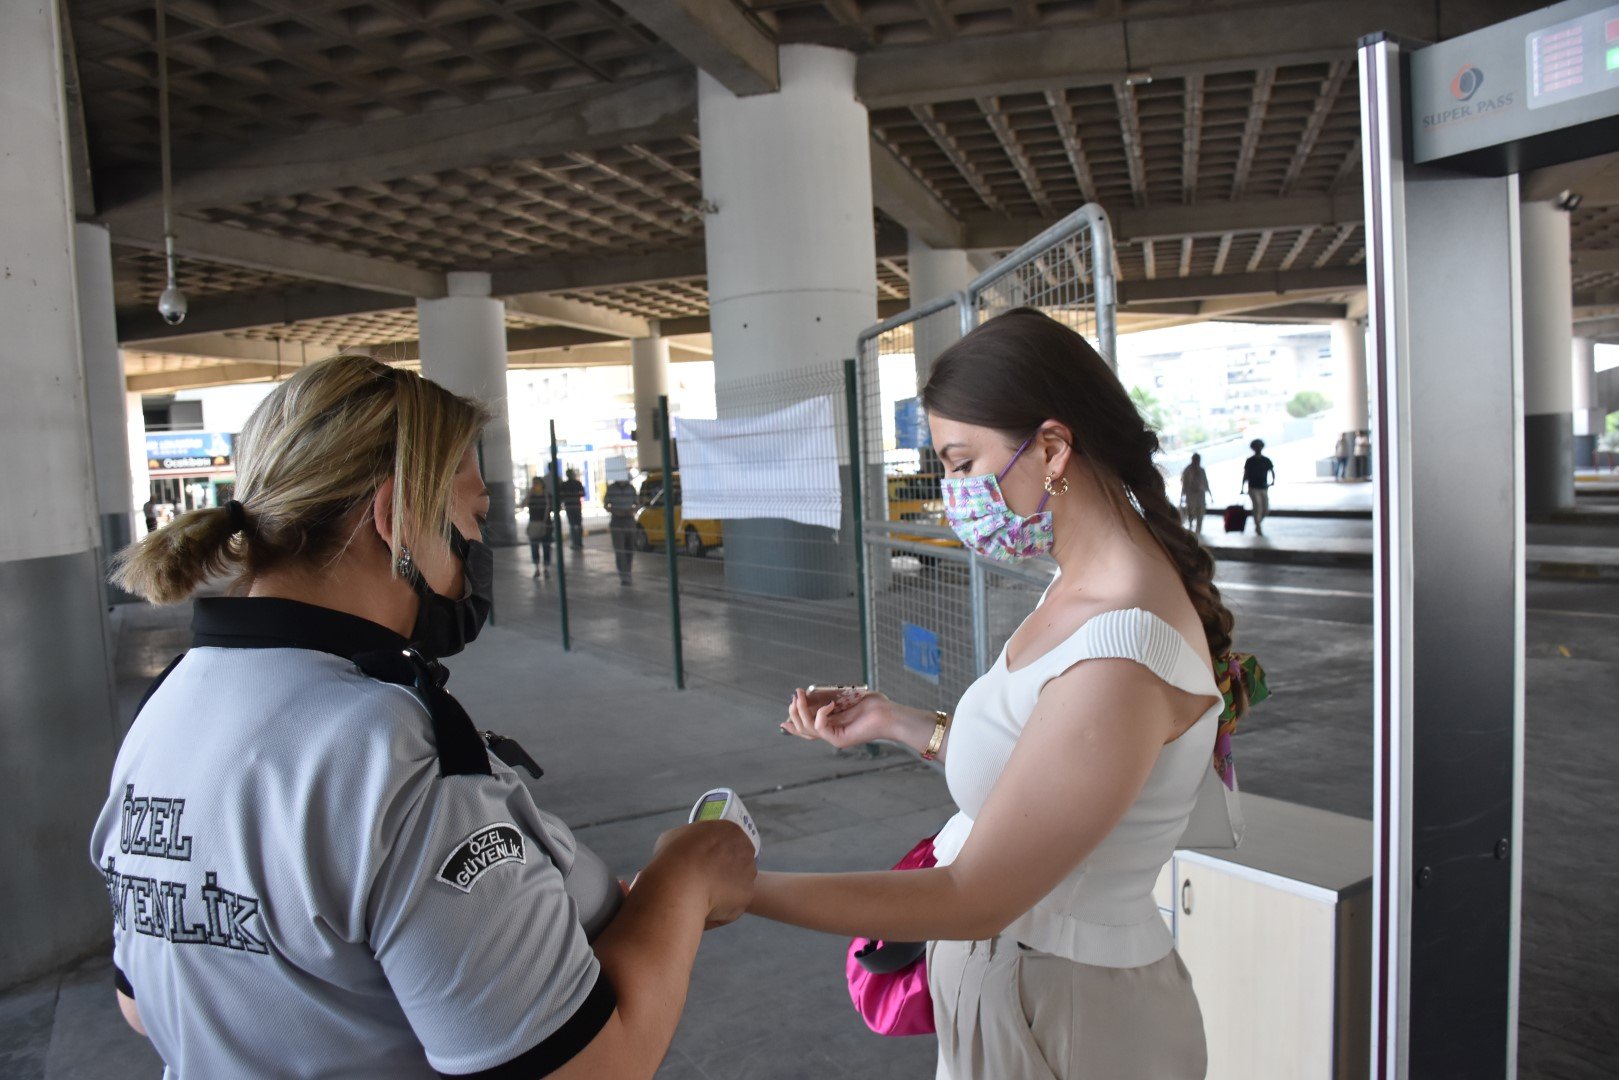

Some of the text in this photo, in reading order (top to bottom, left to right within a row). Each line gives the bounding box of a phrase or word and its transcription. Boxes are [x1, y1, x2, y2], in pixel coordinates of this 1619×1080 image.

[1422, 92, 1514, 128] SUPER PASS
[120, 784, 192, 861] ÖZEL
[468, 830, 504, 855] ÖZEL
[456, 839, 522, 886] GÜVENLİK
